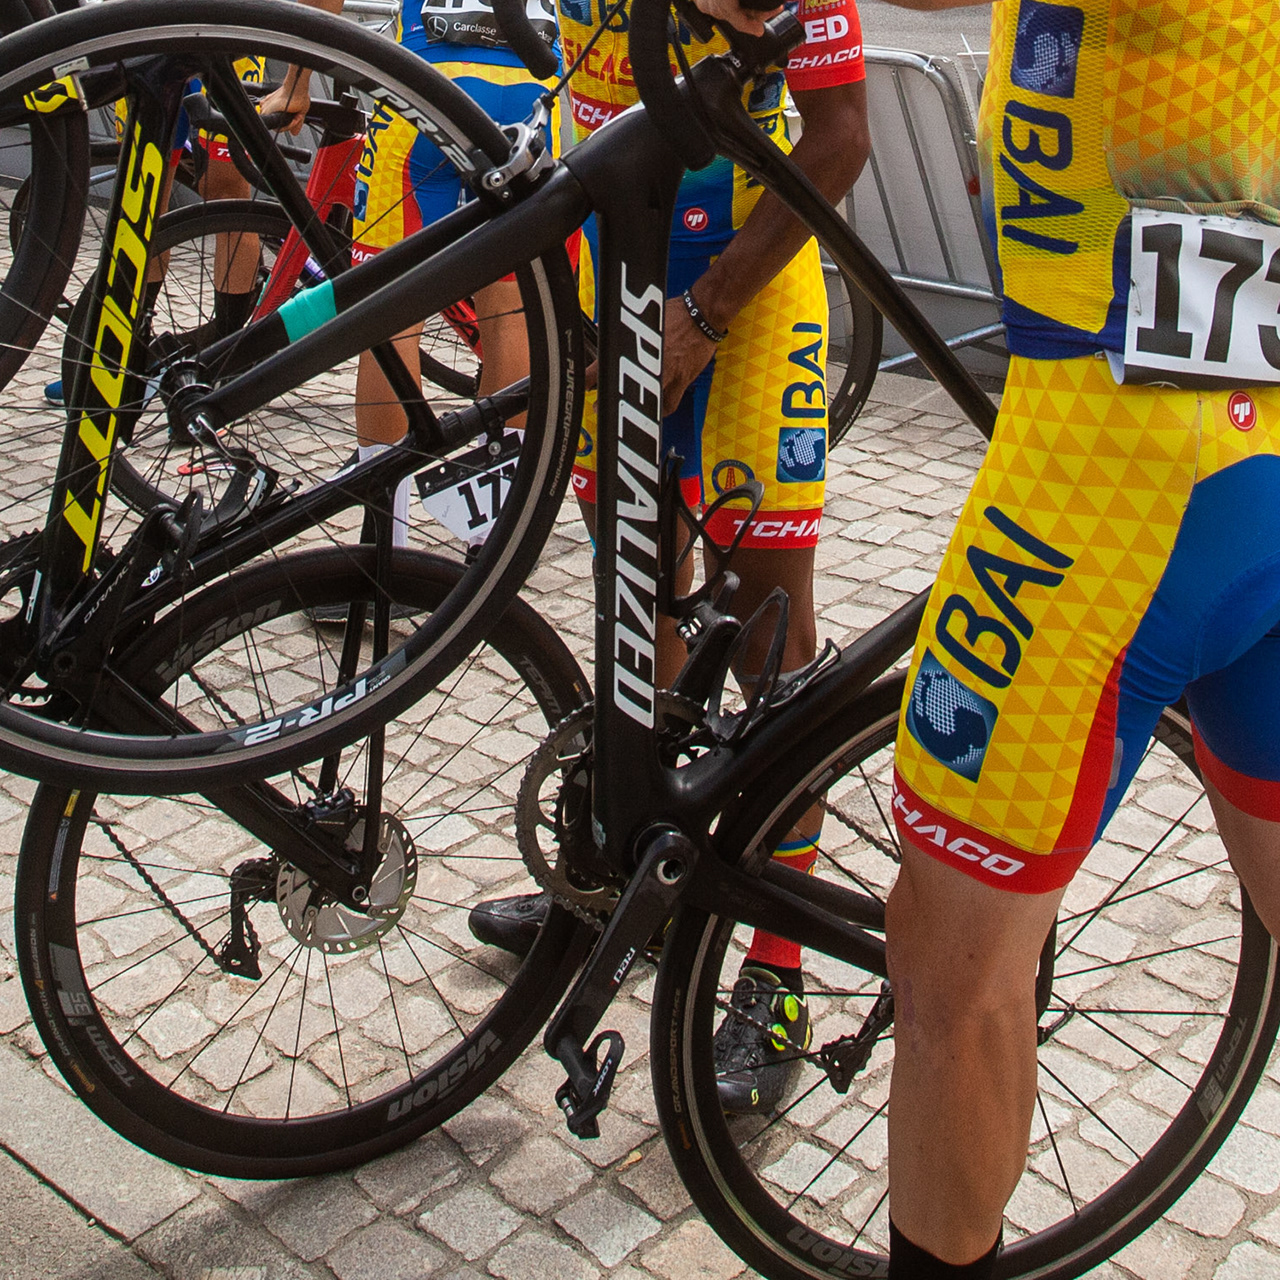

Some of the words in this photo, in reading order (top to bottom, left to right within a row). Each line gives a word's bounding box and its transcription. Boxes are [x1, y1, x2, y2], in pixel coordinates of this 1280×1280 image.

[453, 21, 497, 36] Carclasse
[787, 44, 861, 70] CHACO
[805, 14, 849, 45] ED
[370, 86, 476, 173] PR-2
[999, 100, 1086, 255] BAI
[63, 122, 163, 574] SCOTT
[780, 321, 827, 419] BAI
[613, 261, 665, 729] SPECIALIZED
[733, 518, 821, 538] TCHA
[935, 505, 1074, 690] BAI
[243, 677, 367, 748] PR-2
[891, 789, 1025, 878] HACO
[592, 1057, 613, 1097] LOOK
